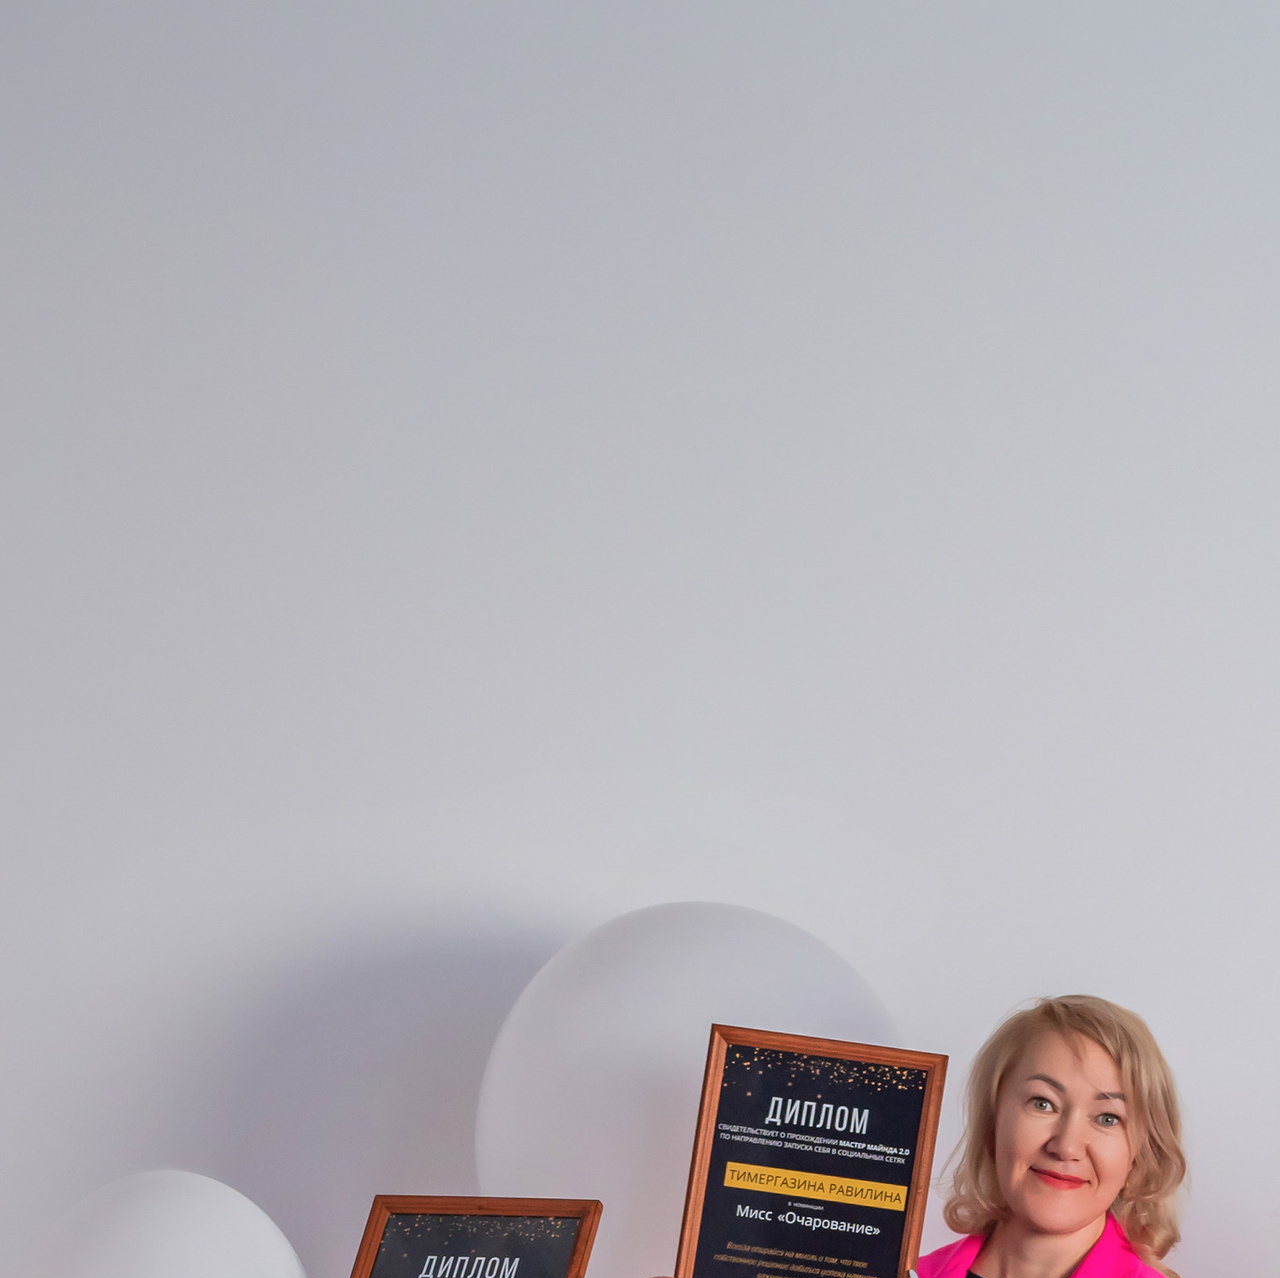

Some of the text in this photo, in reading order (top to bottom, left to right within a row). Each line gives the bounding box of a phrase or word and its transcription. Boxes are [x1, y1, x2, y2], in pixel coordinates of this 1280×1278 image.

[764, 1096, 869, 1134] ДИПЛОМ
[729, 1169, 901, 1204] ТИМЕРГАЗИНА РАВИЛИНА
[736, 1204, 880, 1235] Мисс «Очарование»
